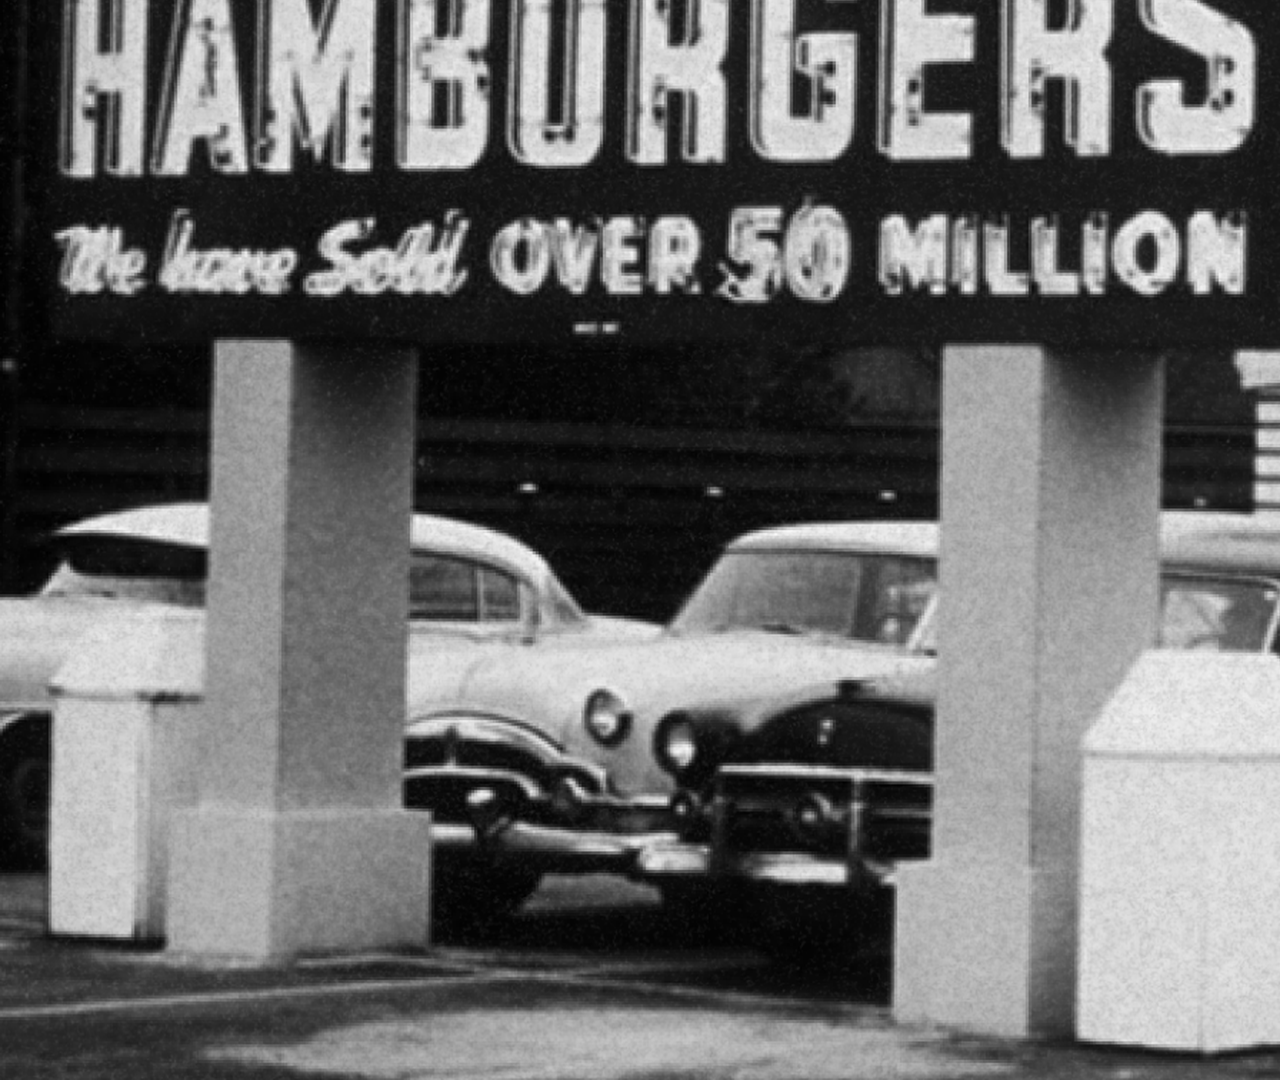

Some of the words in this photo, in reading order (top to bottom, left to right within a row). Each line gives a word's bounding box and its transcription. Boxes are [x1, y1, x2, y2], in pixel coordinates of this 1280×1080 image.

[55, 225, 147, 294] We
[159, 209, 297, 294] have
[303, 209, 469, 297] Sold
[490, 216, 701, 294] OVER
[718, 203, 851, 303] 50
[878, 211, 1247, 296] MILLION
